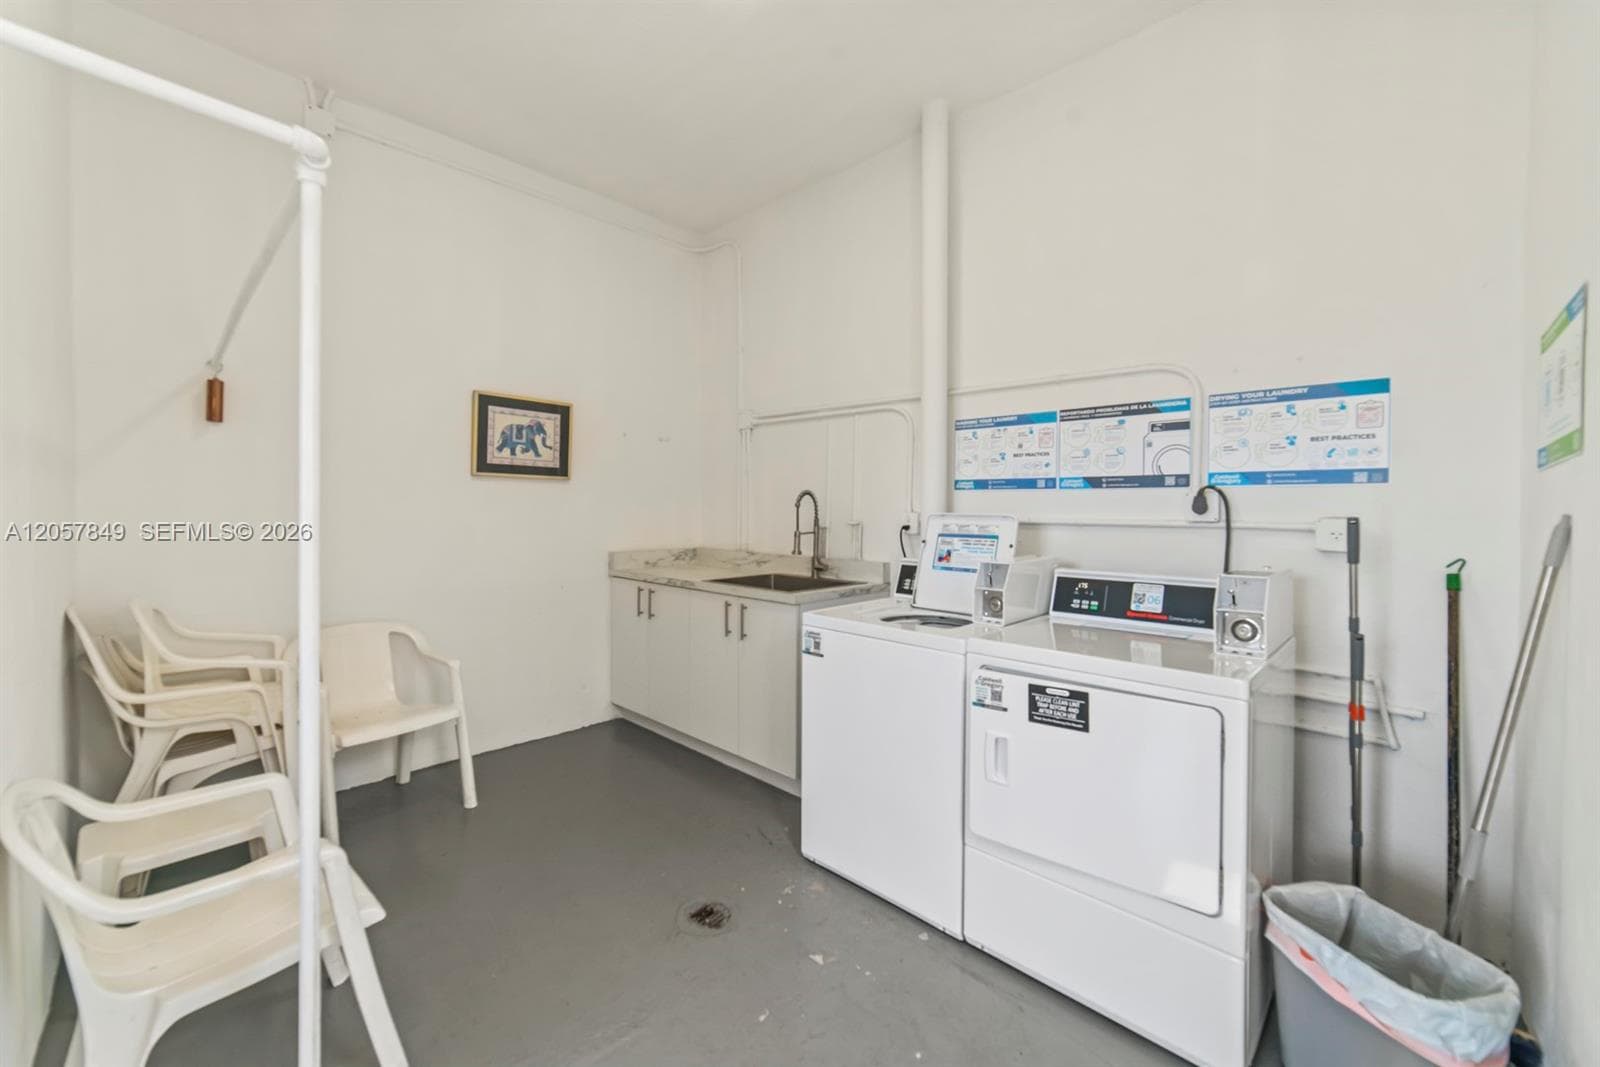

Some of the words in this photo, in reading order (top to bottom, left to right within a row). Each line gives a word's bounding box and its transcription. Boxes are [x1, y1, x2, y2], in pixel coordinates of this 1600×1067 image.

[1209, 393, 1240, 402] DRYING
[1241, 391, 1265, 399] YOUR
[1266, 387, 1309, 397] LAUNDRY
[1331, 433, 1377, 441] PRACTICES
[1147, 594, 1161, 605] 06
[1035, 696, 1052, 704] PLEASE
[1052, 698, 1068, 706] CLEAN
[1067, 706, 1080, 714] AND
